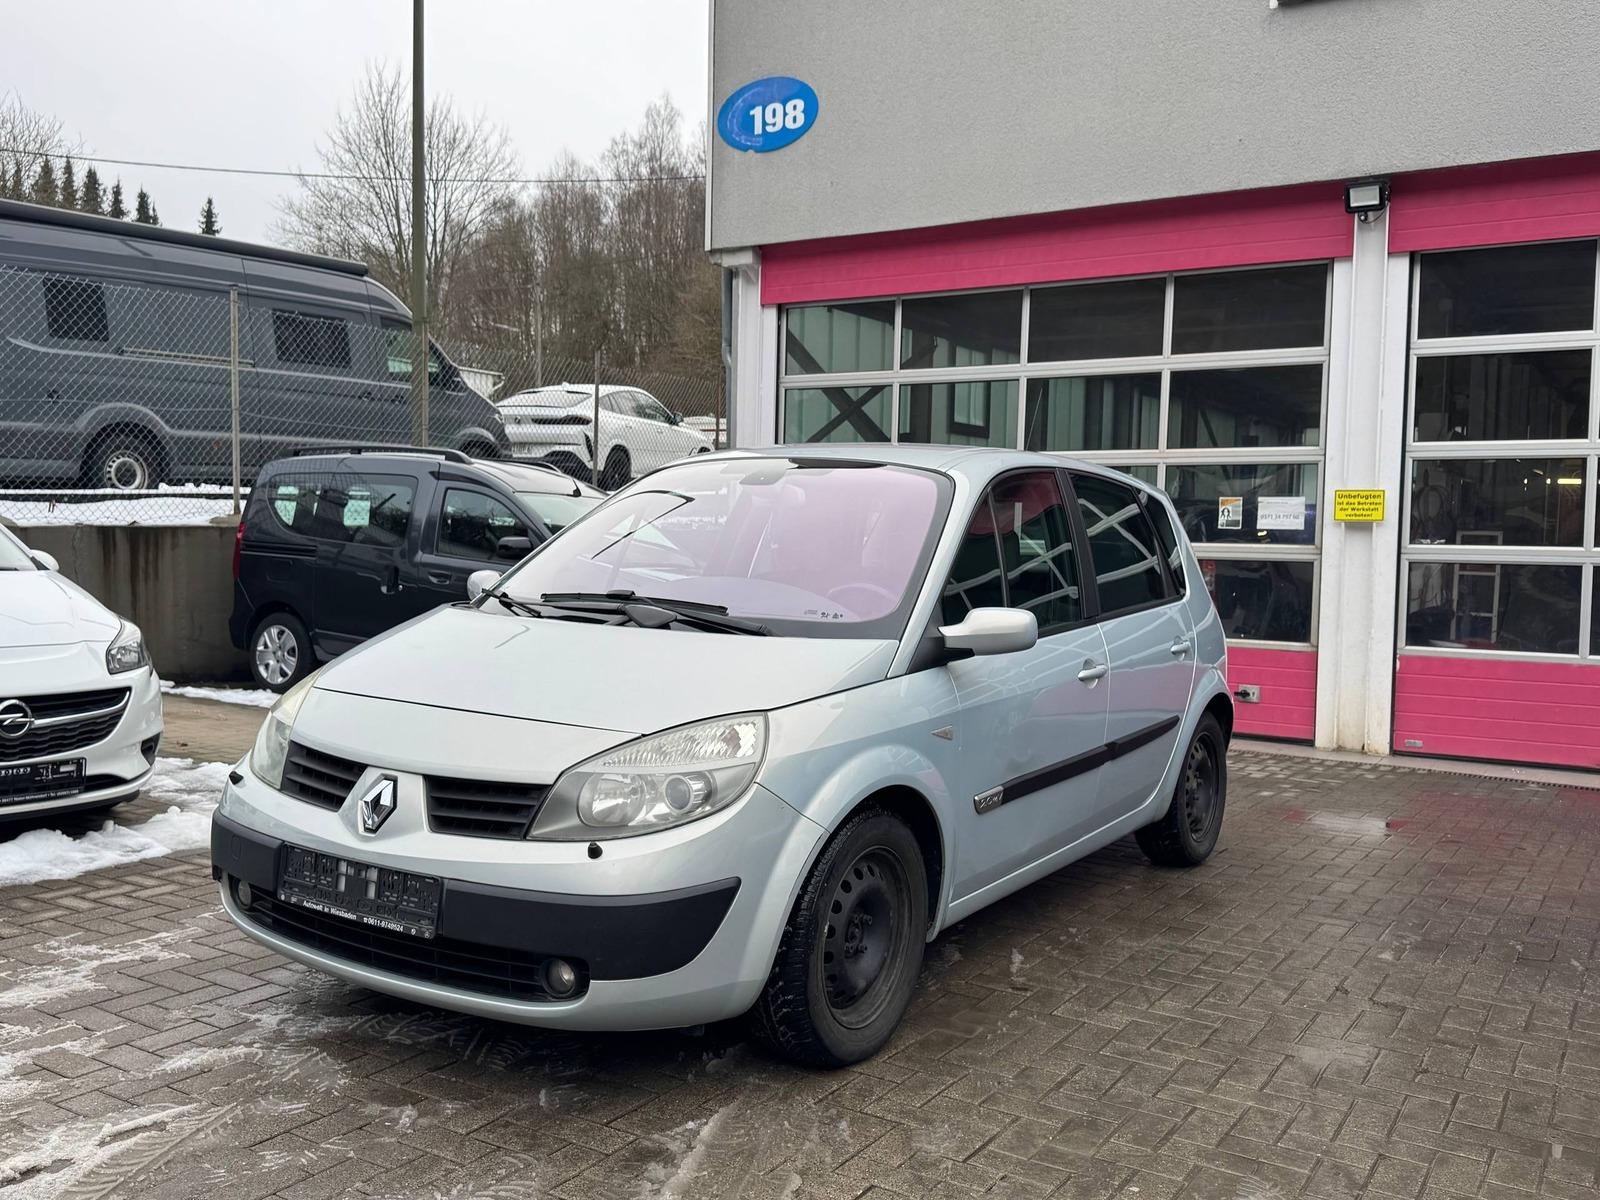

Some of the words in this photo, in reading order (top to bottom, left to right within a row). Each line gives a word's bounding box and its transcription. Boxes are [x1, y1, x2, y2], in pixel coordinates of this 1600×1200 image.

[749, 98, 805, 135] 198
[302, 900, 324, 912] Autowelt
[330, 907, 357, 920] Wiesbaden
